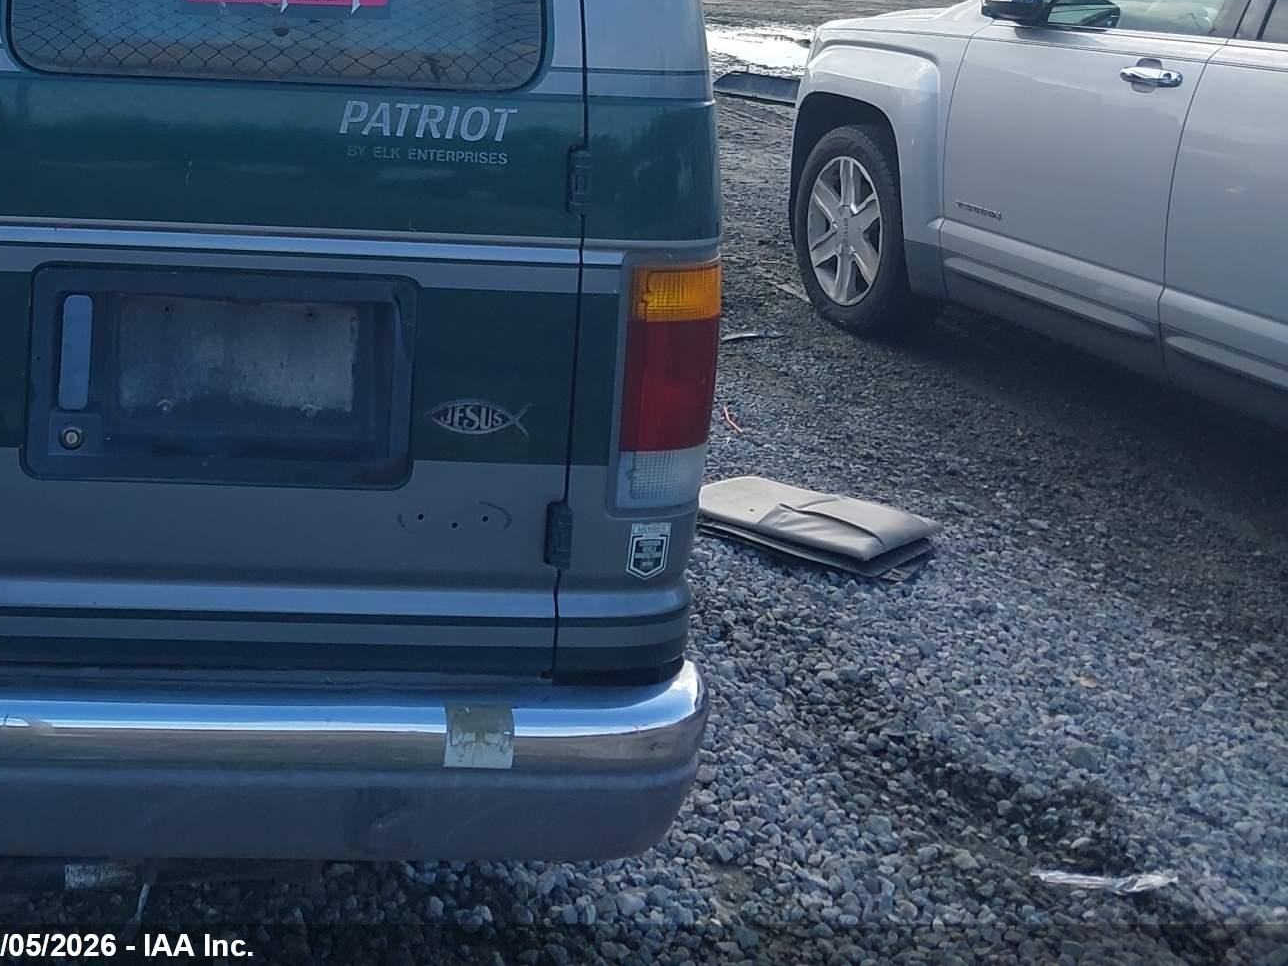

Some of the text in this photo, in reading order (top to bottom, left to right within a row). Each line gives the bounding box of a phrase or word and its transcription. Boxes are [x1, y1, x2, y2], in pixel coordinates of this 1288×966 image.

[338, 100, 518, 142] PATRIOT
[347, 145, 508, 165] BY ELK ENTERPRISES
[440, 405, 503, 430] JESUS
